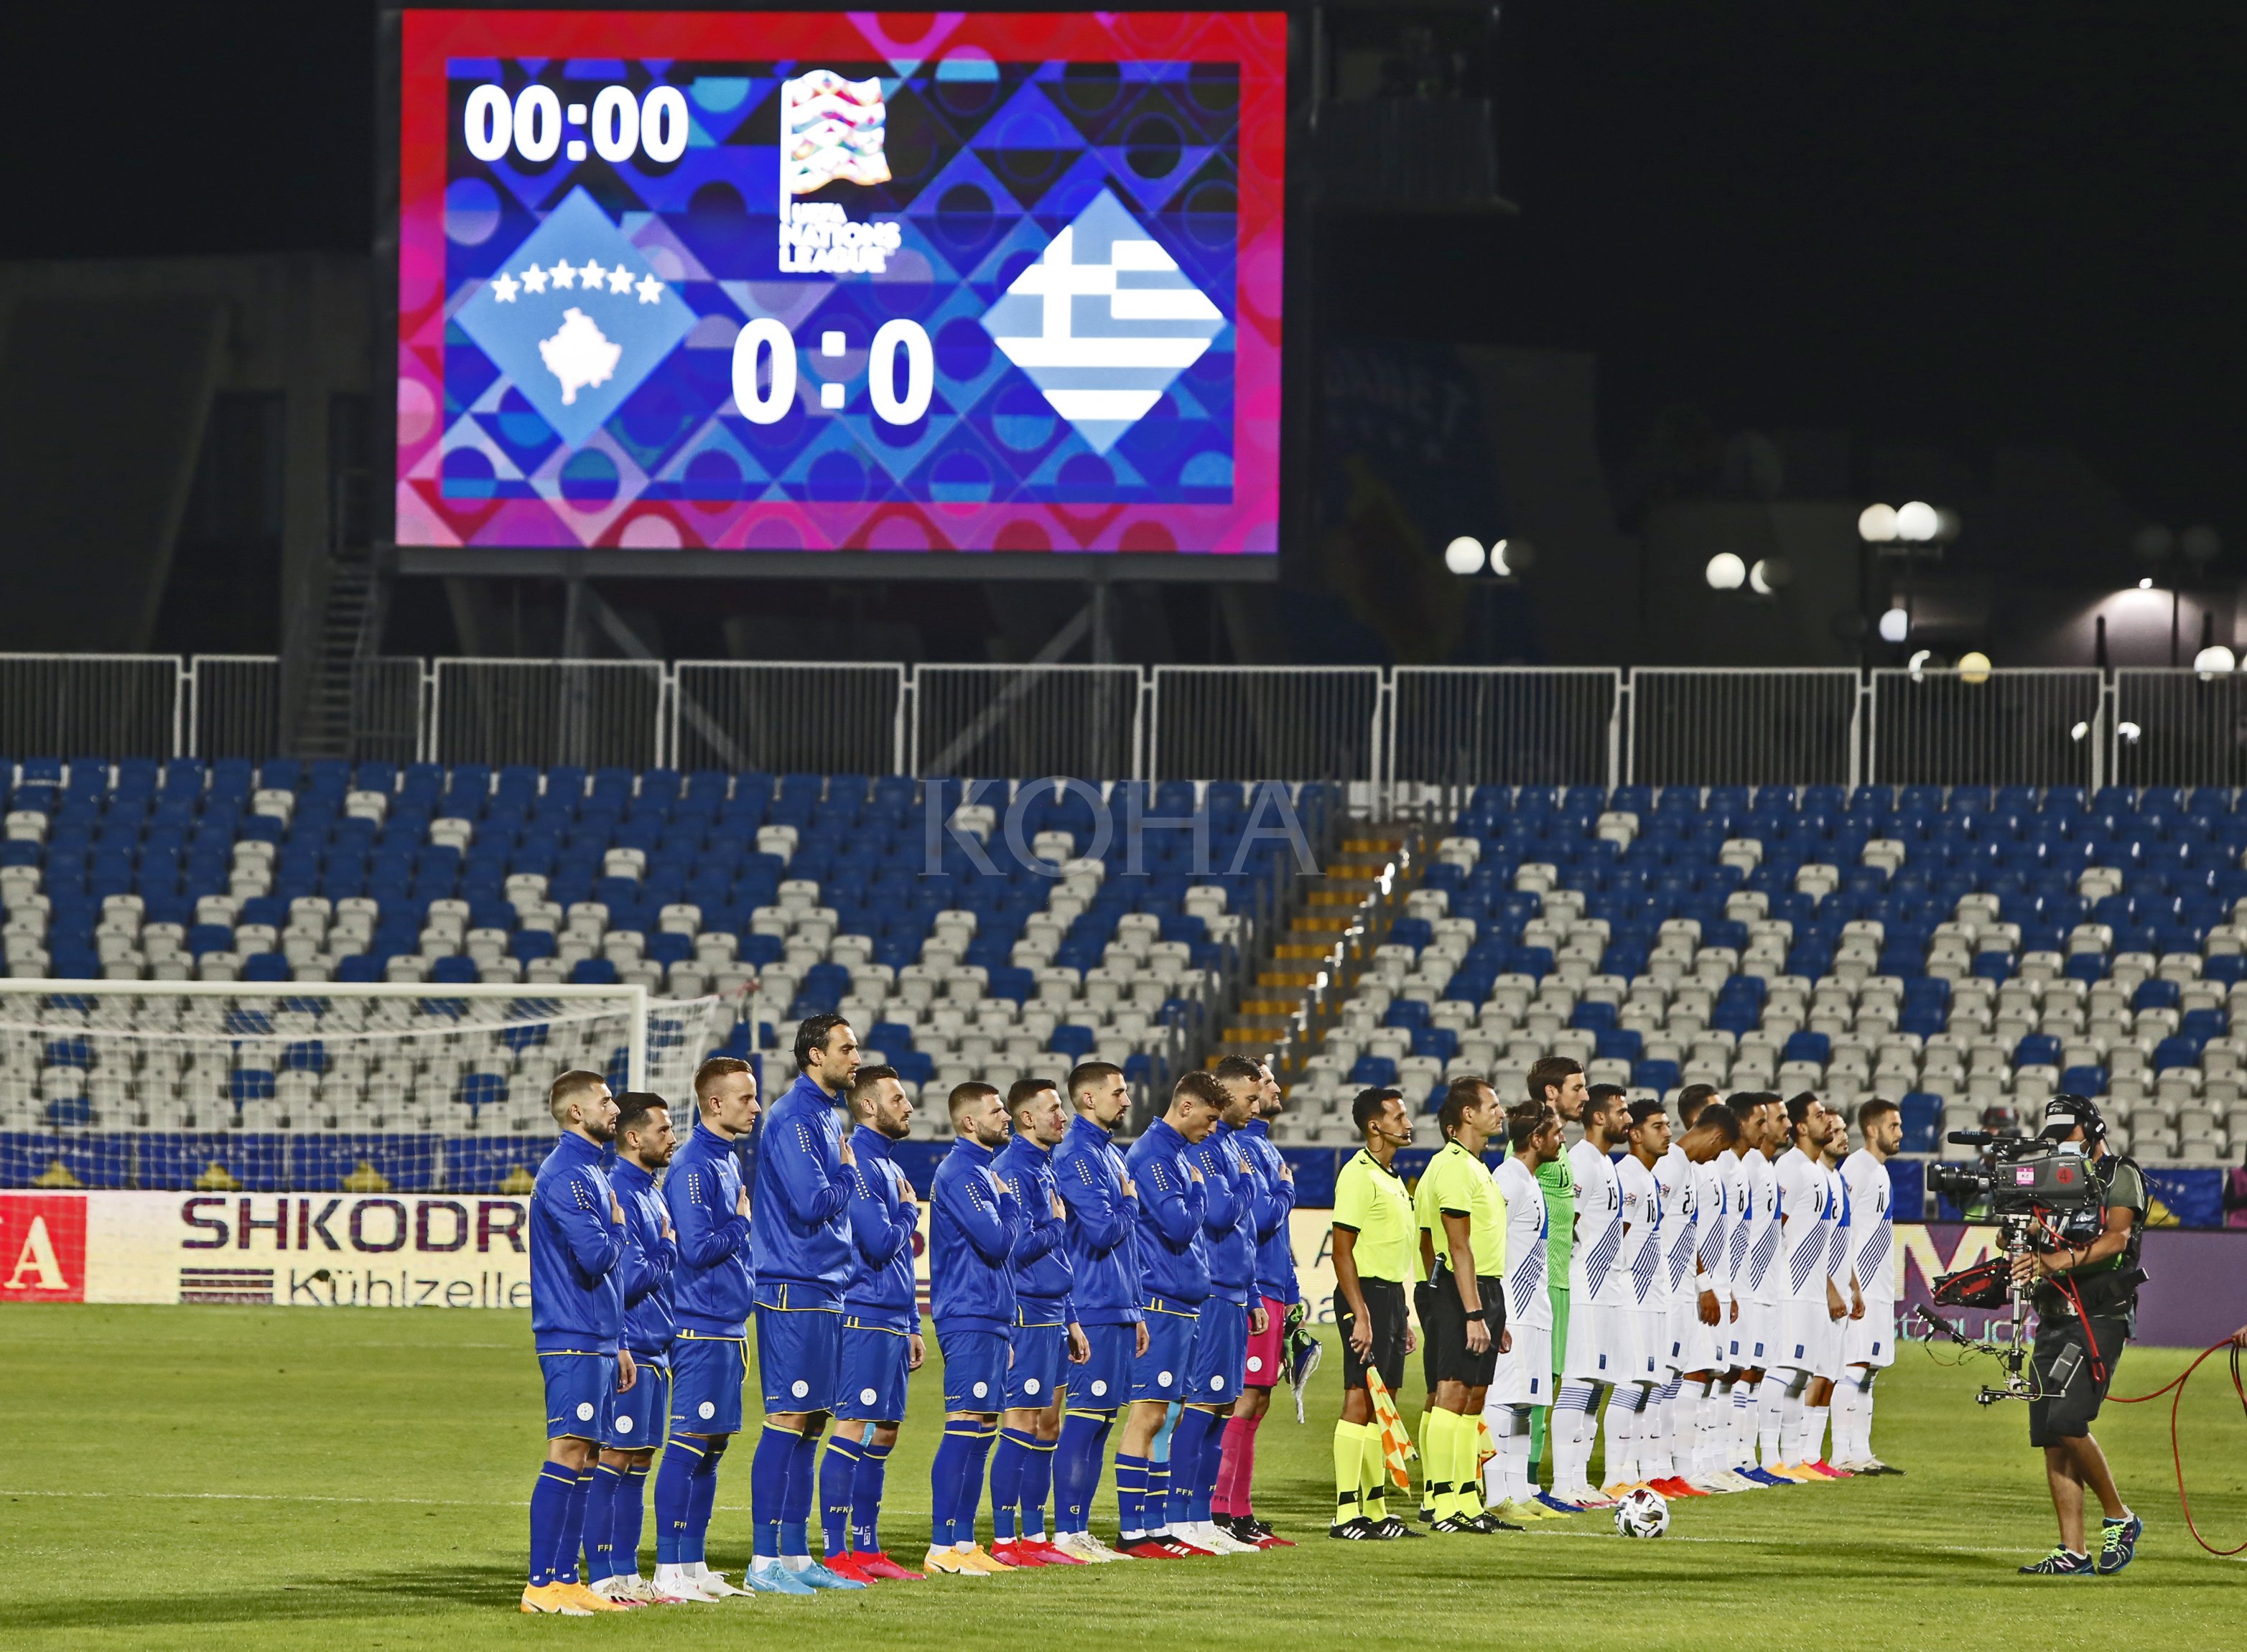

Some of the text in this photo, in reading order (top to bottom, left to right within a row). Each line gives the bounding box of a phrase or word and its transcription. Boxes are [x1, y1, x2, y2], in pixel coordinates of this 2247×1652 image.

[465, 84, 689, 162] 00:00
[779, 222, 901, 250] NATIONS
[779, 246, 886, 273] LEAGUE
[2059, 1168, 2068, 1182] 4
[181, 1197, 527, 1254] SHKODR
[290, 1269, 531, 1308] Kühlzelle
